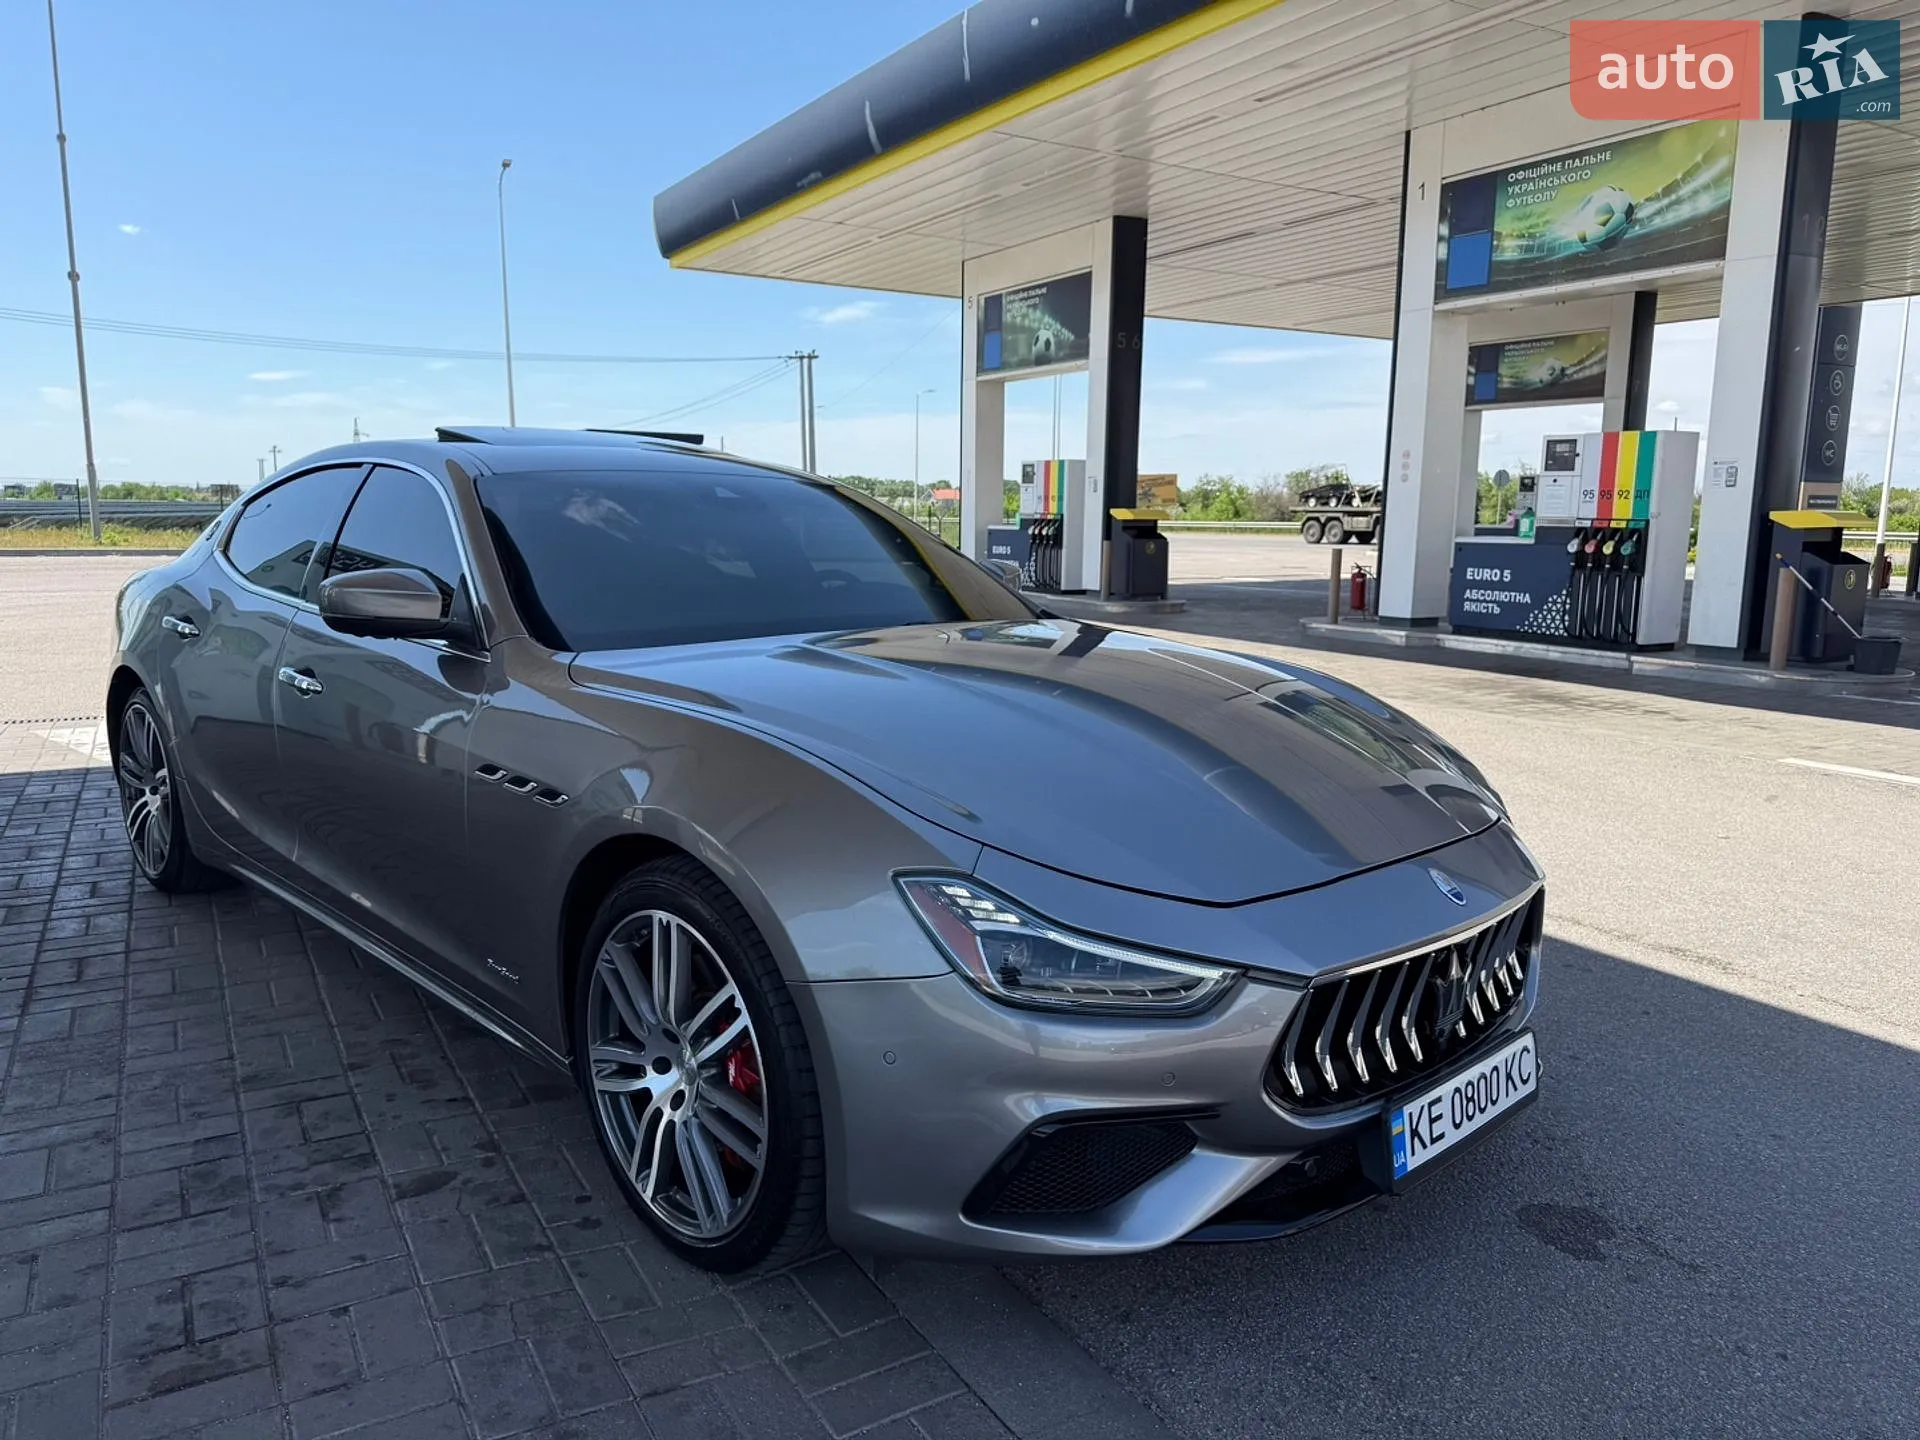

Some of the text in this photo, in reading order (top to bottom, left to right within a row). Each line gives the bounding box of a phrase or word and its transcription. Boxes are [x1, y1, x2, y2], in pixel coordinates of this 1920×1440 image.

[1507, 150, 1612, 182] ОФІЦІЙНЕ ПАЛЬНЕ
[1507, 169, 1591, 195] УКРАЇНСЬКОГО
[1417, 182, 1425, 200] 1
[1506, 189, 1558, 208] ФУТБОЛУ
[1117, 332, 1141, 349] 5 6
[1582, 489, 1595, 500] 95
[1599, 489, 1612, 500] 95
[1617, 489, 1630, 500] 92
[1466, 567, 1512, 582] EURO 5
[1463, 588, 1531, 604] АБСОЛЮТНА
[1463, 601, 1501, 614] ЯКІСТЬ
[1408, 1045, 1532, 1157] KE 0800 KC
[1393, 1151, 1406, 1168] UA
